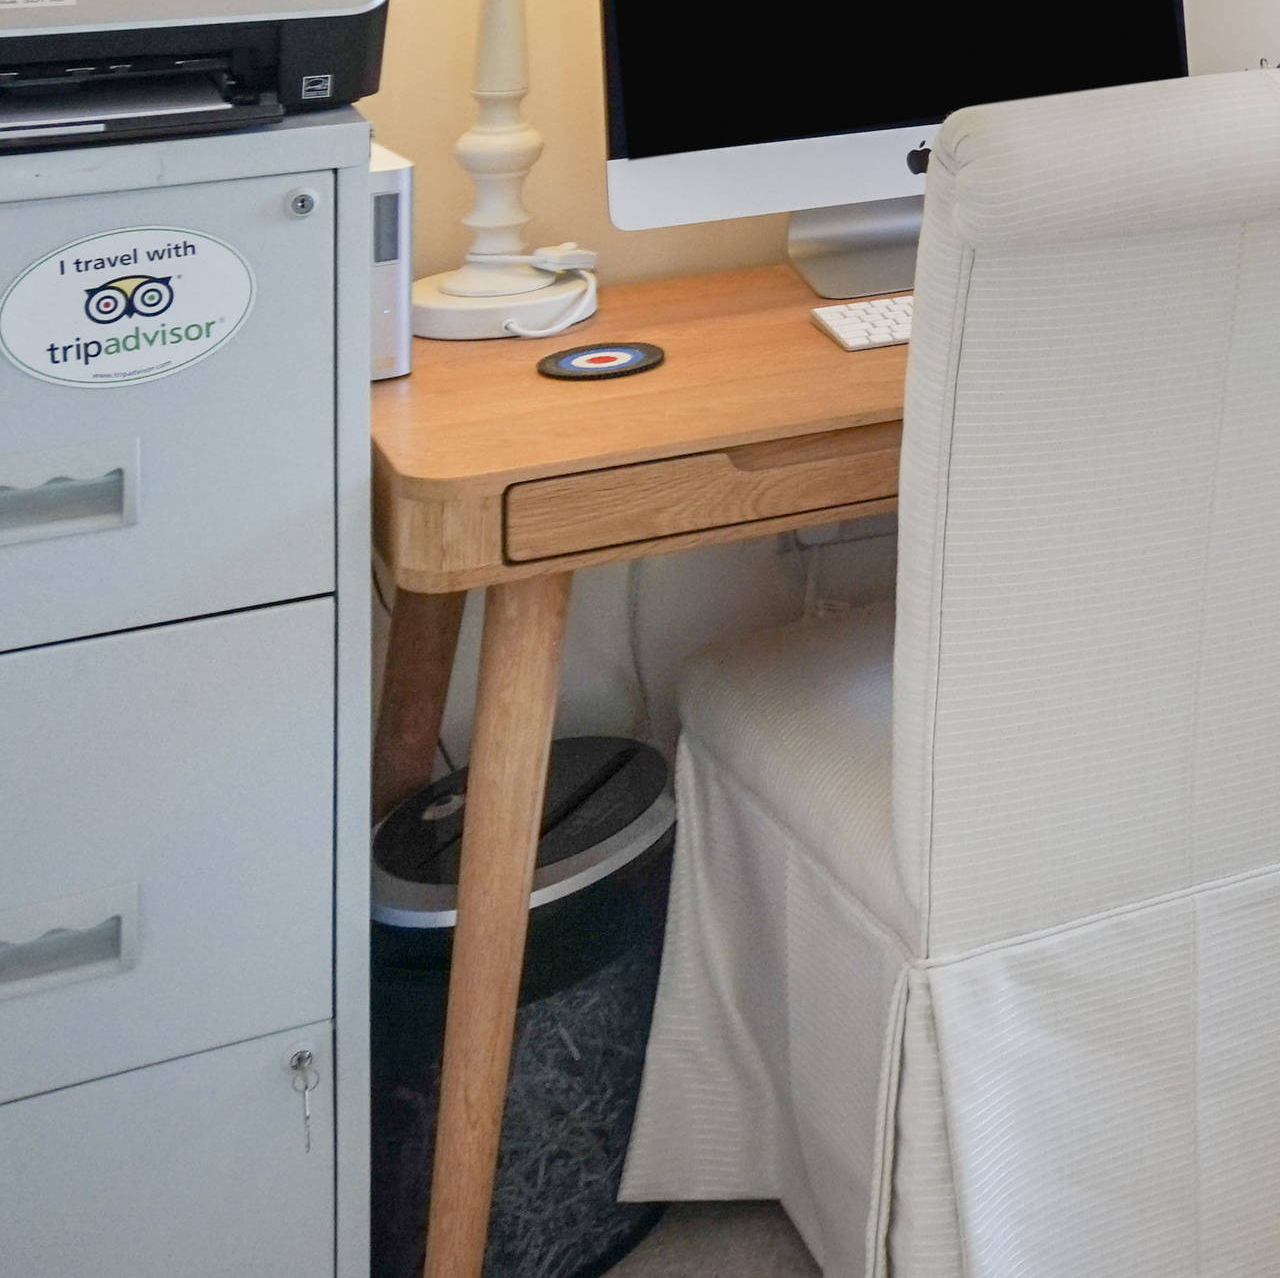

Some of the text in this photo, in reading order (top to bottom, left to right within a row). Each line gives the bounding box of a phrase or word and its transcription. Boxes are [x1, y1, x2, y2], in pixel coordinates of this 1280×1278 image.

[60, 240, 197, 275] I travel with
[46, 320, 217, 365] tripadvisor
[92, 360, 173, 379] www.tripadvisor.com
